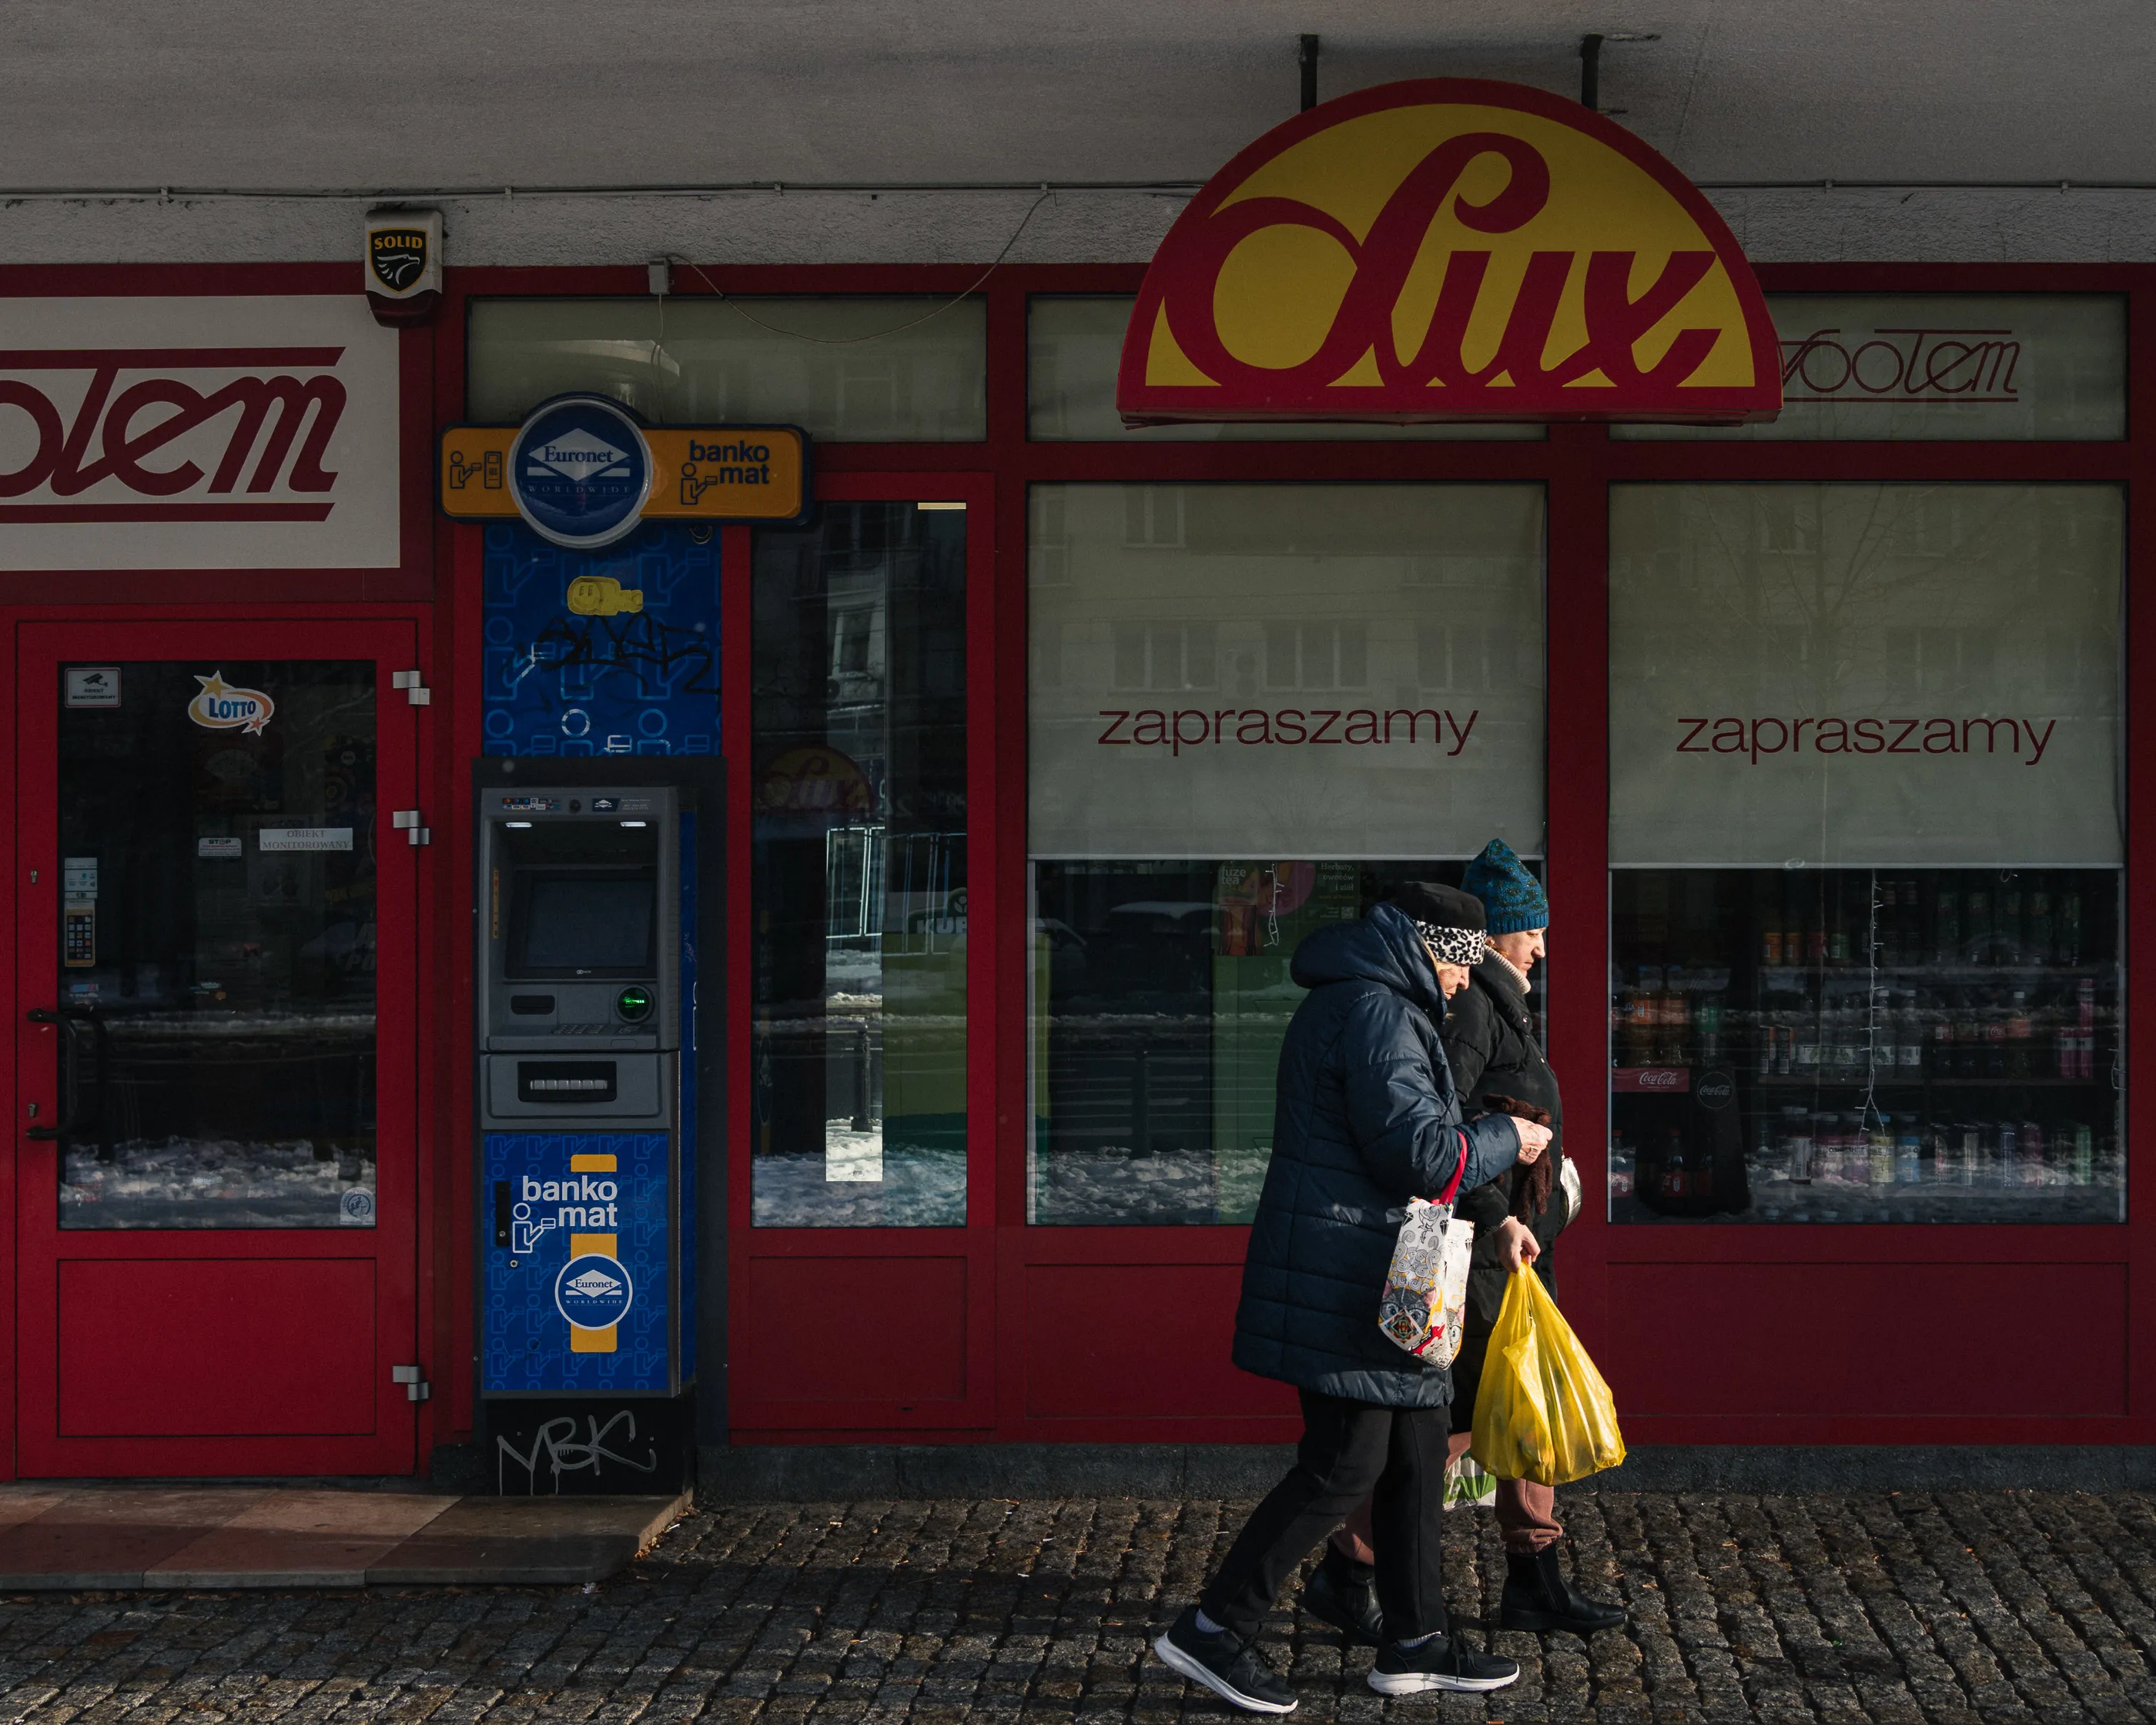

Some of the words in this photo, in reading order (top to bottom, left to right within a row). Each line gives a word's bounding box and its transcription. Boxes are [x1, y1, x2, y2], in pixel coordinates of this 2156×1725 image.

[374, 236, 423, 250] SOLID
[543, 446, 613, 463] Euronet
[690, 440, 770, 464] banko
[719, 464, 770, 485] mat
[527, 485, 631, 494] WORLDWIDE
[209, 698, 256, 718] LOTTO
[1098, 709, 1478, 757] zapraszamy
[1676, 717, 2056, 765] zapraszamy
[263, 841, 350, 849] MONITOROWANY
[1222, 865, 1247, 877] fuze
[522, 1175, 618, 1201] banko
[558, 1203, 618, 1227] mat
[575, 1278, 613, 1288] Euronet
